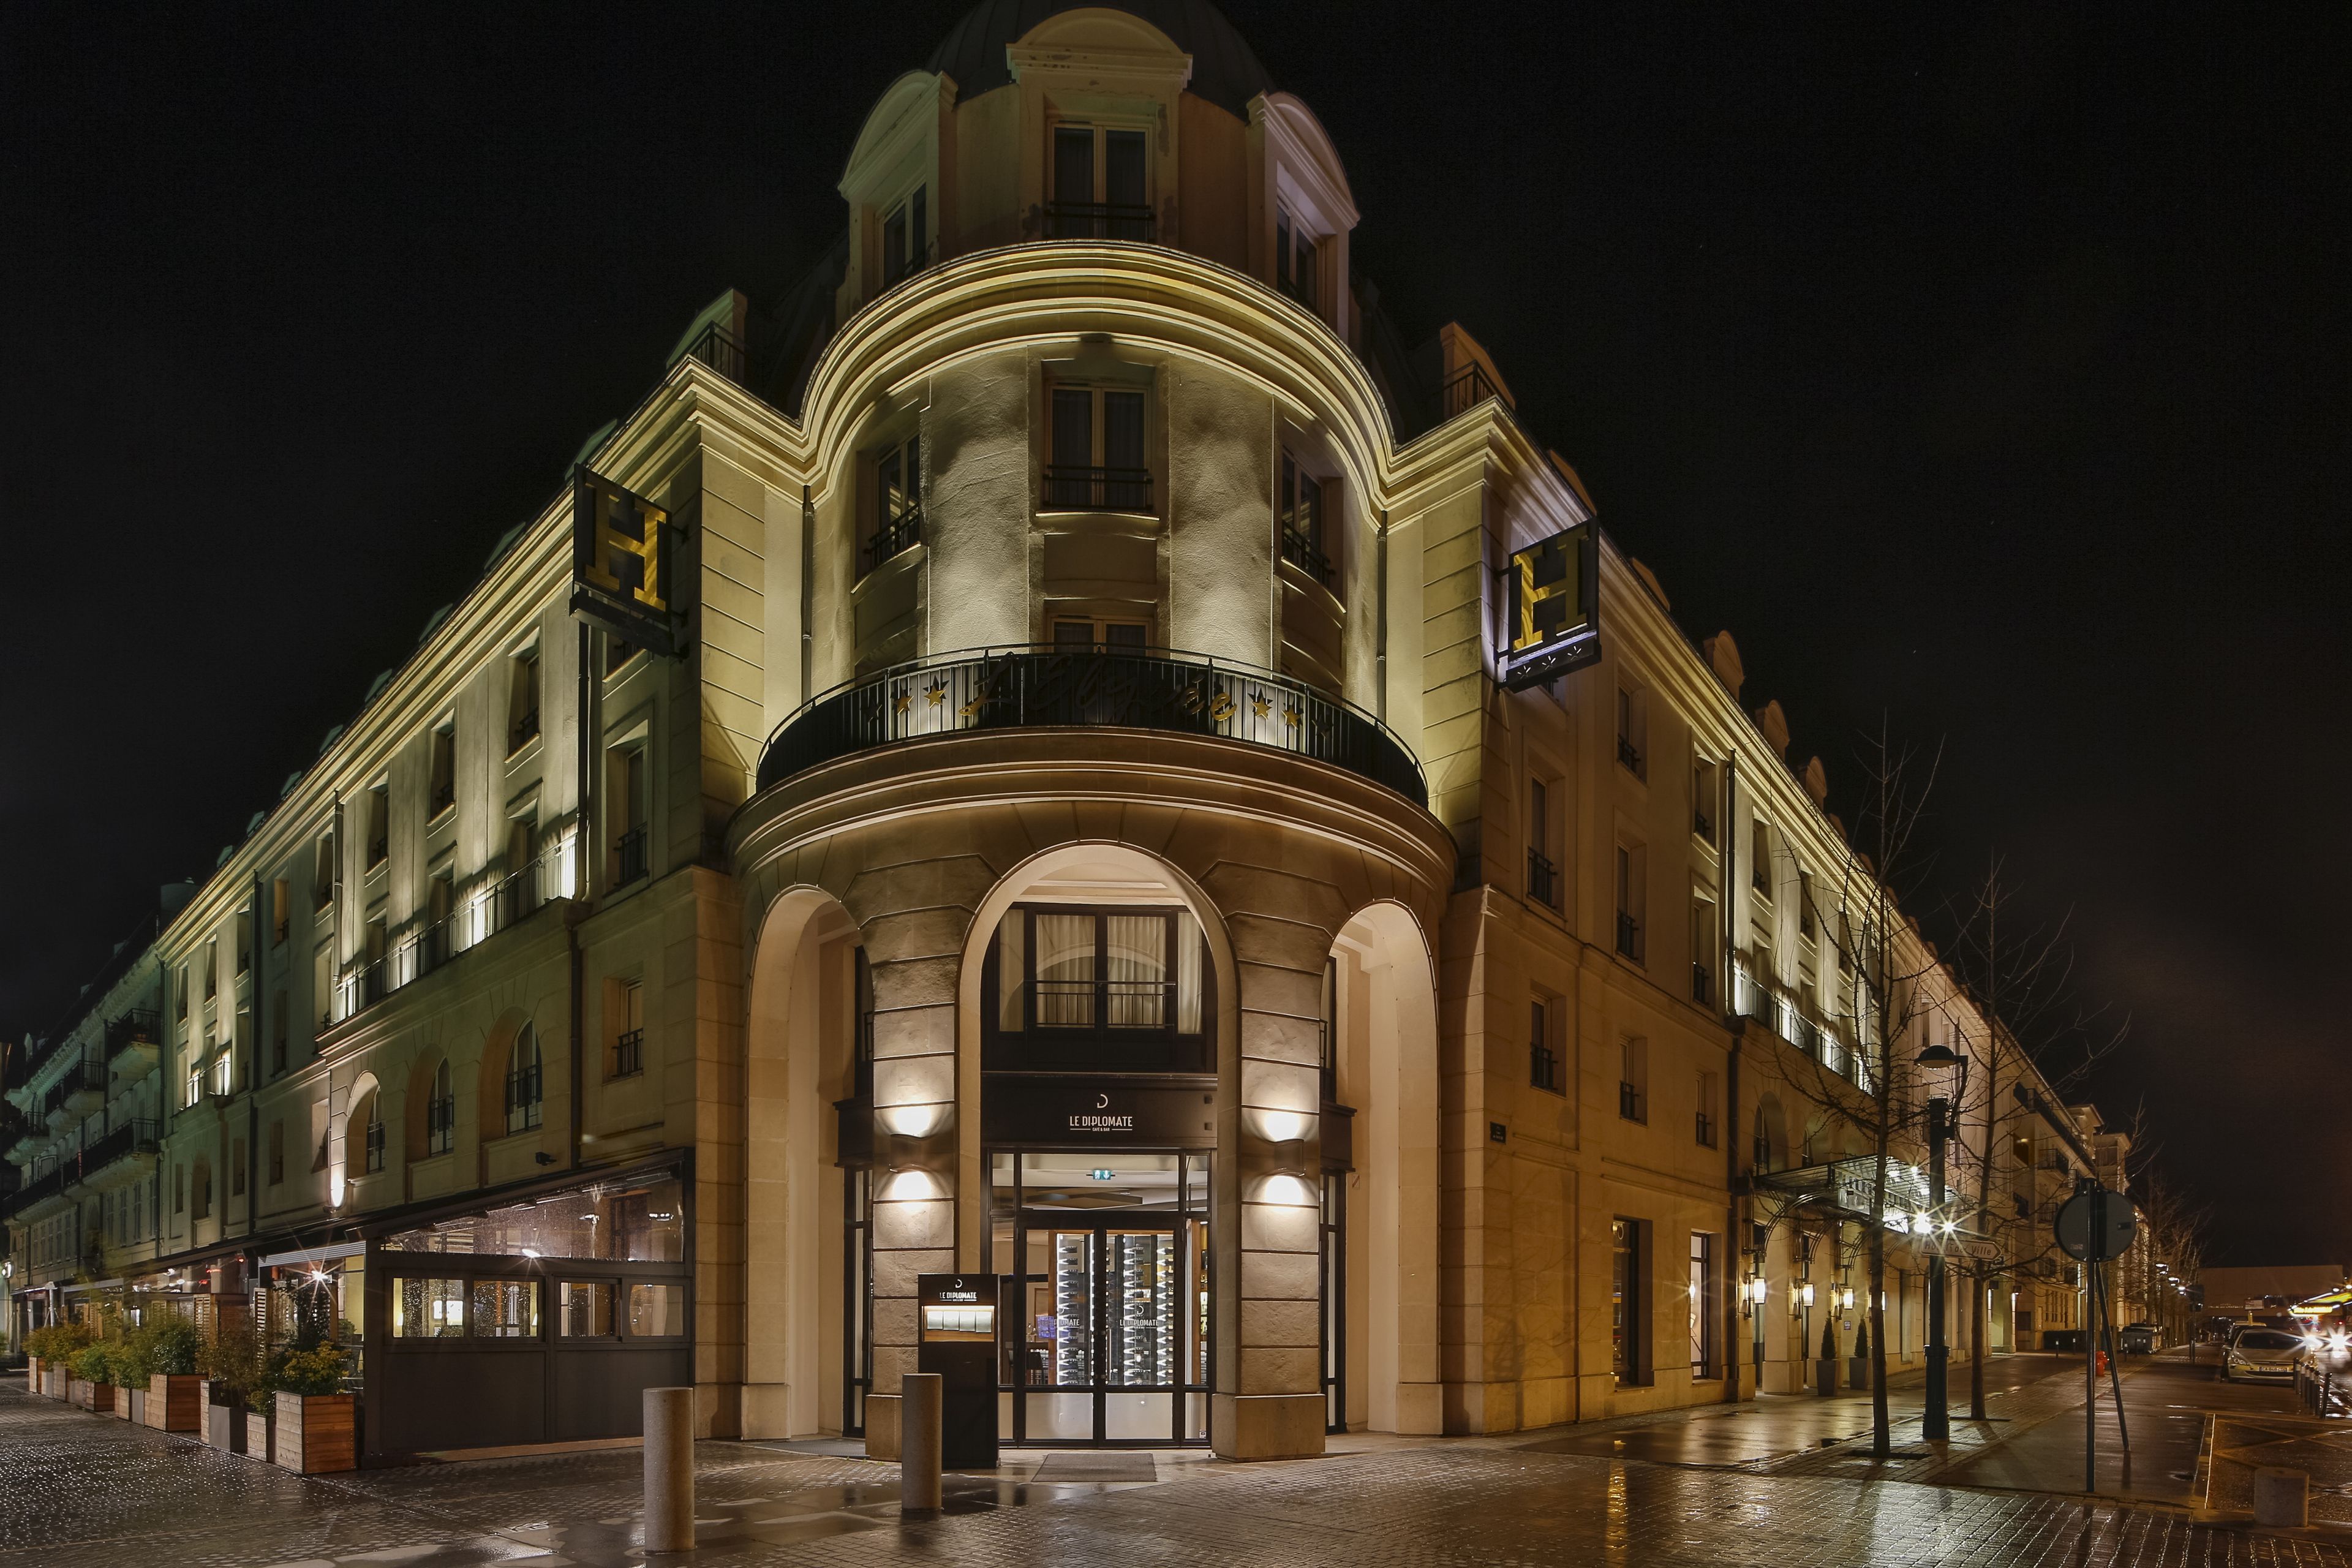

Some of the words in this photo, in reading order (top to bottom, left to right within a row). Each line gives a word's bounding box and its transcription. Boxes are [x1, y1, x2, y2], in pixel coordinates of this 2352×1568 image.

[584, 472, 666, 612] H
[1513, 526, 1589, 654] H
[1070, 1116, 1079, 1126] LE
[1082, 1116, 1133, 1127] DIPLOMATE
[1971, 1244, 1991, 1255] Ville
